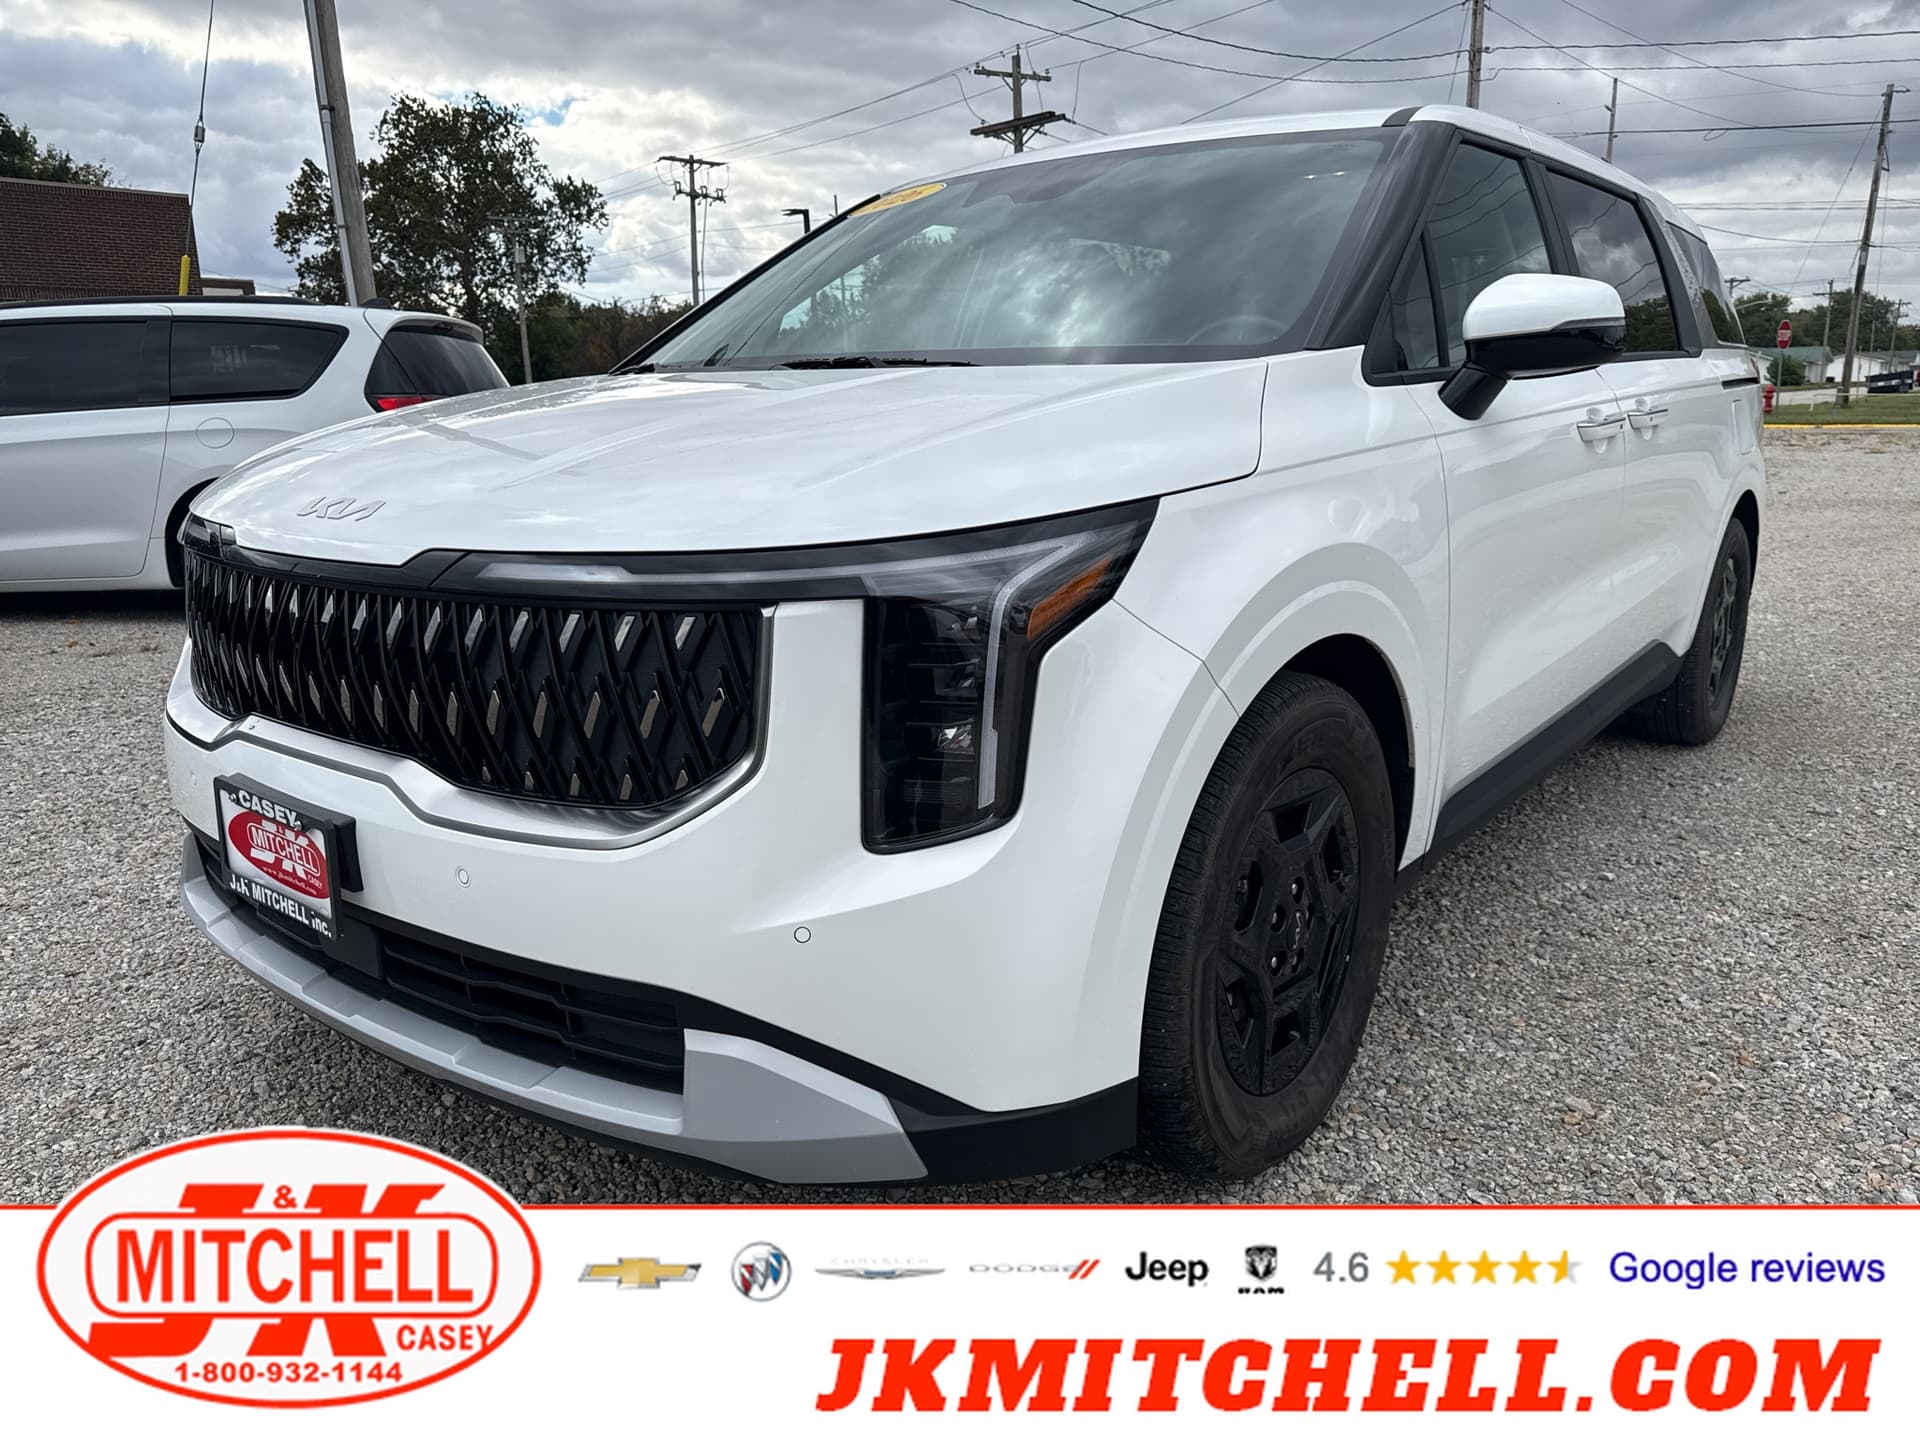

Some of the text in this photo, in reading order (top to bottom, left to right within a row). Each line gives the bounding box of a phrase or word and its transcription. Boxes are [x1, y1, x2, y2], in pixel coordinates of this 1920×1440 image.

[296, 496, 387, 522] KIA
[238, 789, 297, 828] CASEY
[250, 826, 318, 873] MITCHELL
[251, 882, 310, 926] MITCHELL
